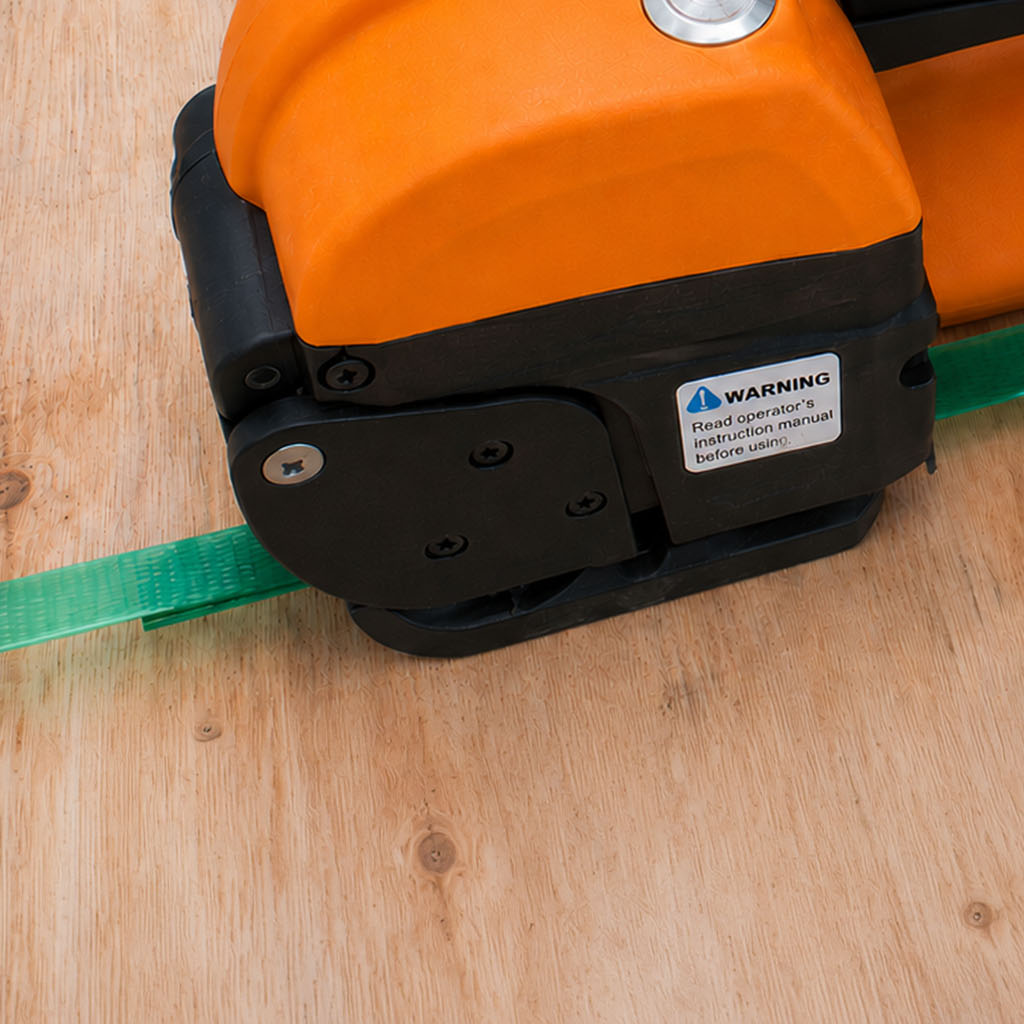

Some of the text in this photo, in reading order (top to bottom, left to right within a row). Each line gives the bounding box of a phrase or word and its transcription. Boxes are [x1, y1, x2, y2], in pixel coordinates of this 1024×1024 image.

[724, 372, 830, 404] WARNING
[692, 398, 815, 433] Read operator's
[693, 409, 834, 449] instruction manual
[695, 446, 744, 464] before
